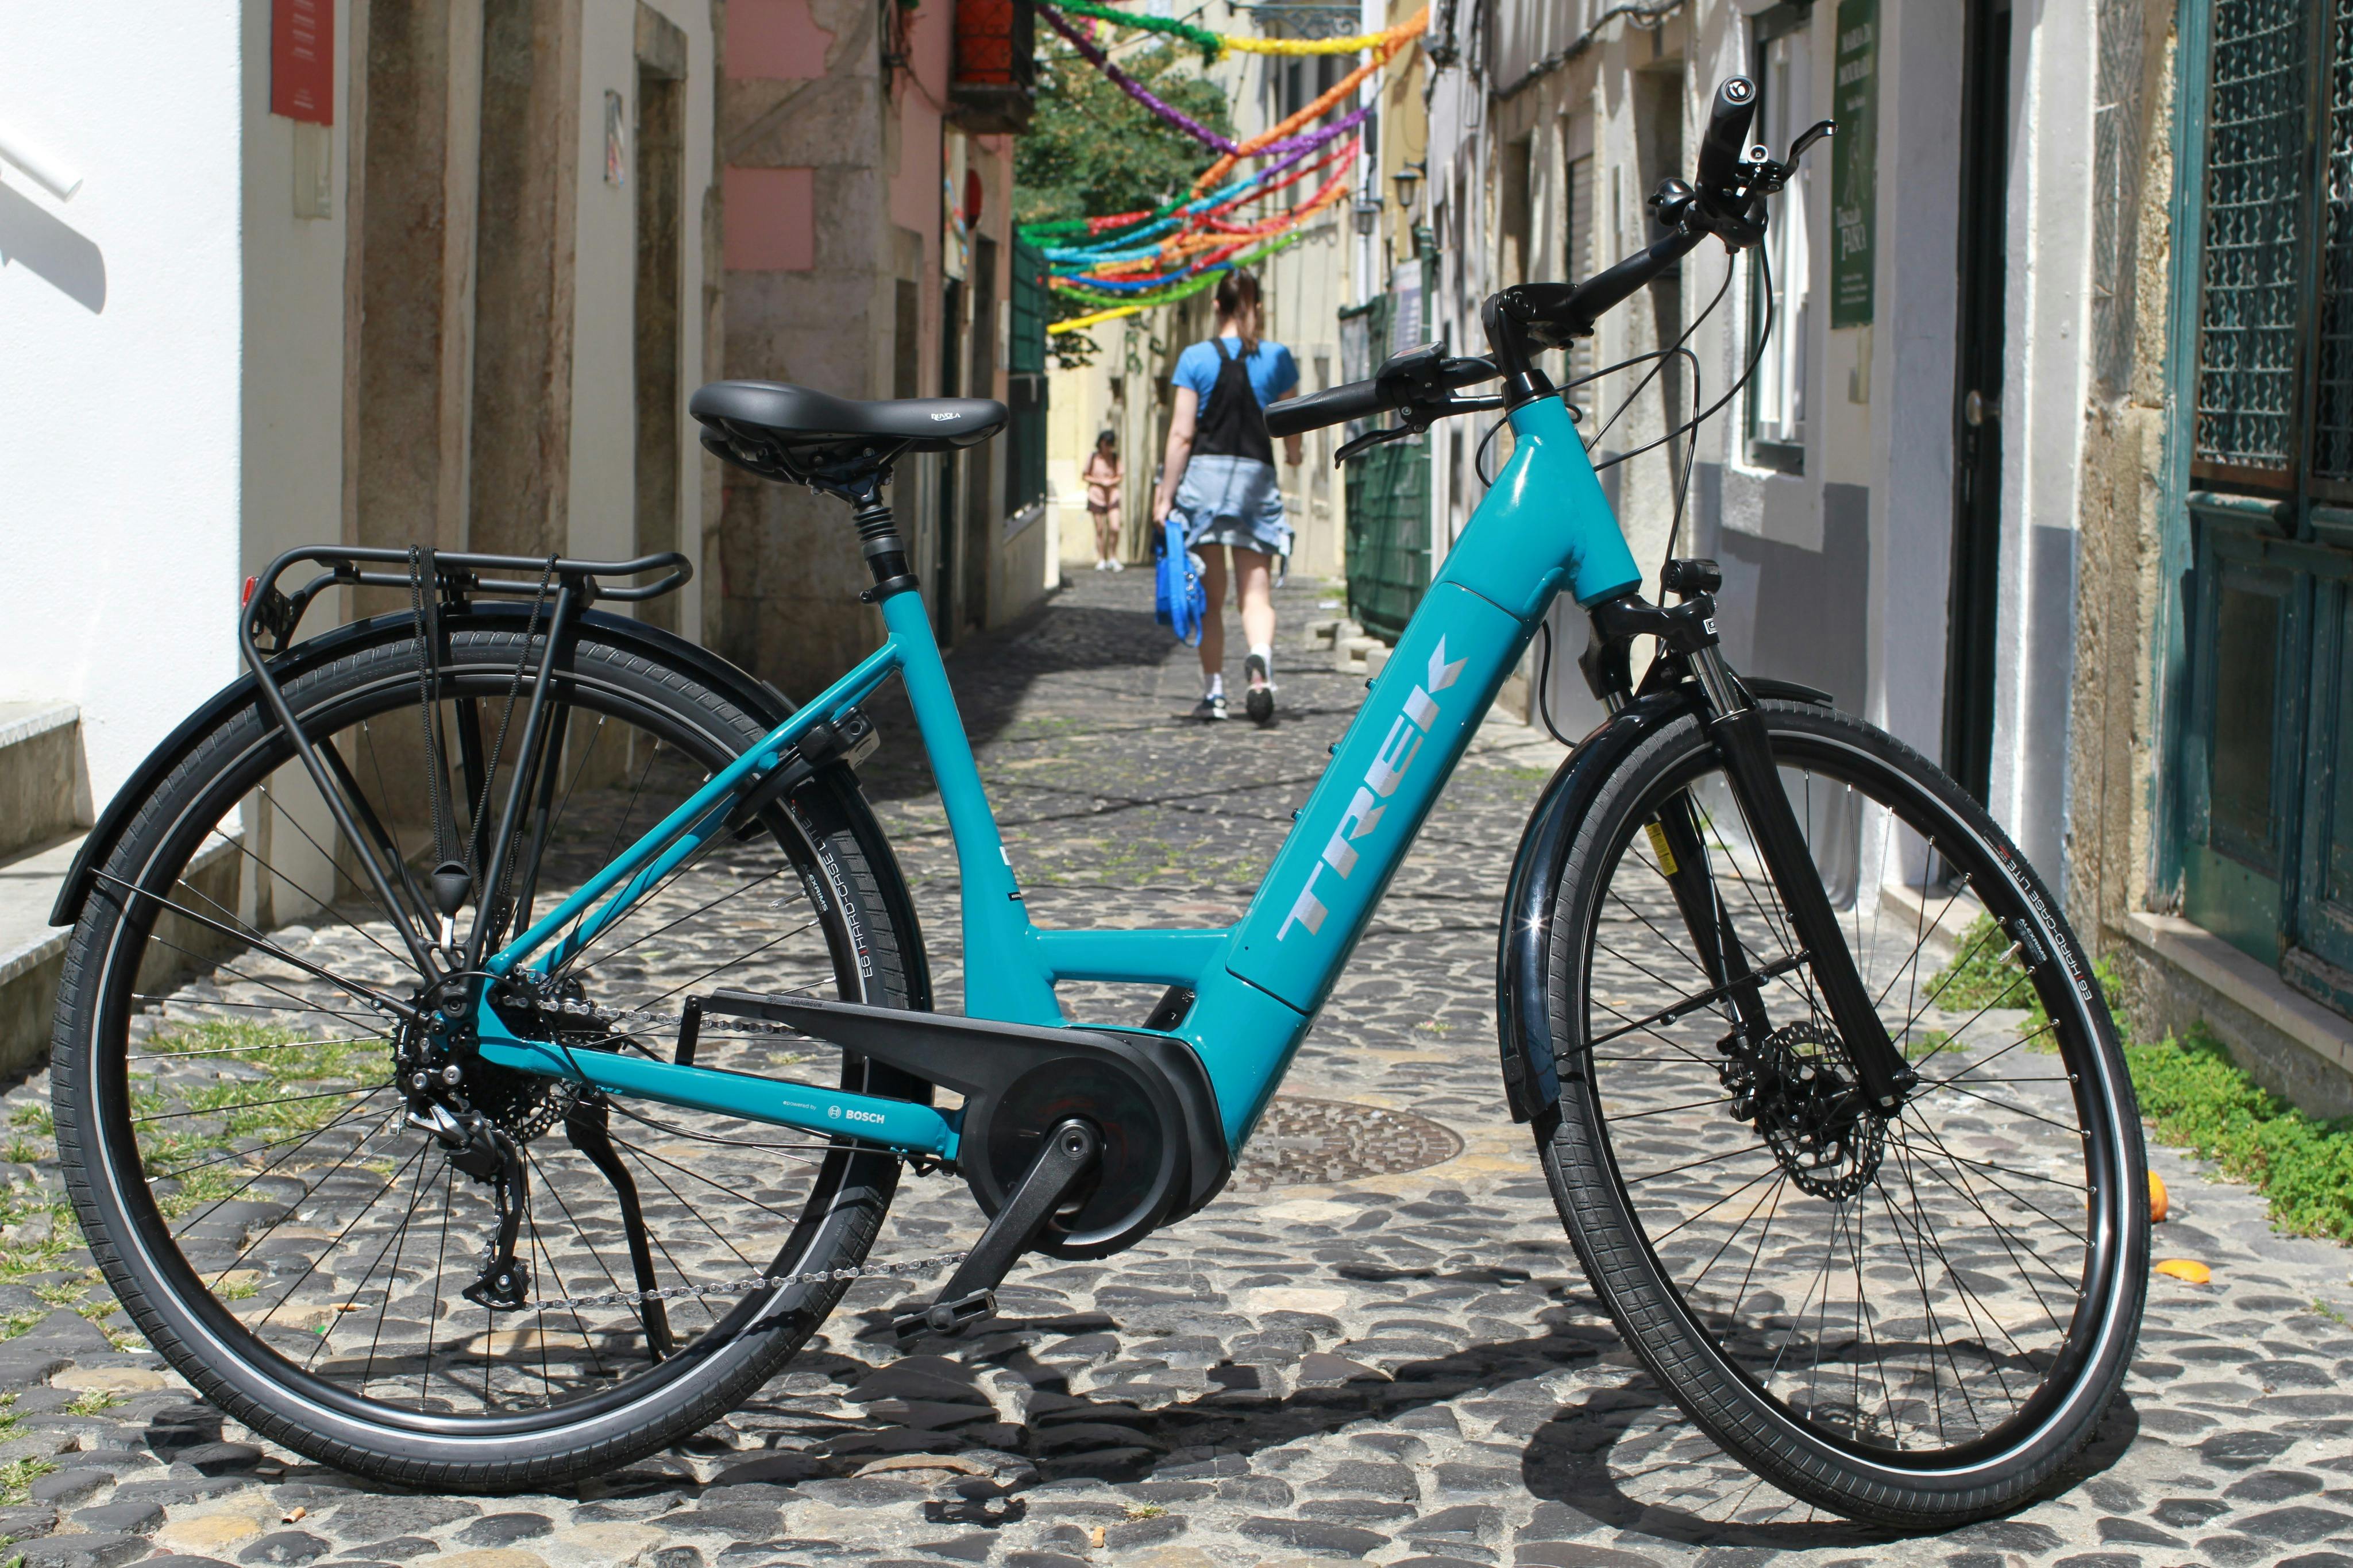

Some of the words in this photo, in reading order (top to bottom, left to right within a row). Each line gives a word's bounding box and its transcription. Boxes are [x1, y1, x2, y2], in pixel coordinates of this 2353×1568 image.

[931, 412, 961, 421] NUVOLA
[1276, 632, 1469, 942] TREK
[801, 817, 826, 851] LITE
[803, 864, 828, 912] ALEXRIMS
[2007, 860, 2031, 890] LITE
[823, 852, 866, 949] HARD-CASE
[2019, 918, 2048, 961] ALEXRIMS
[2028, 891, 2081, 976] HARD-CASE
[861, 955, 873, 978] E6
[2078, 979, 2092, 1001] E6
[783, 1100, 809, 1110] epowered
[846, 1109, 885, 1124] BOSCH
